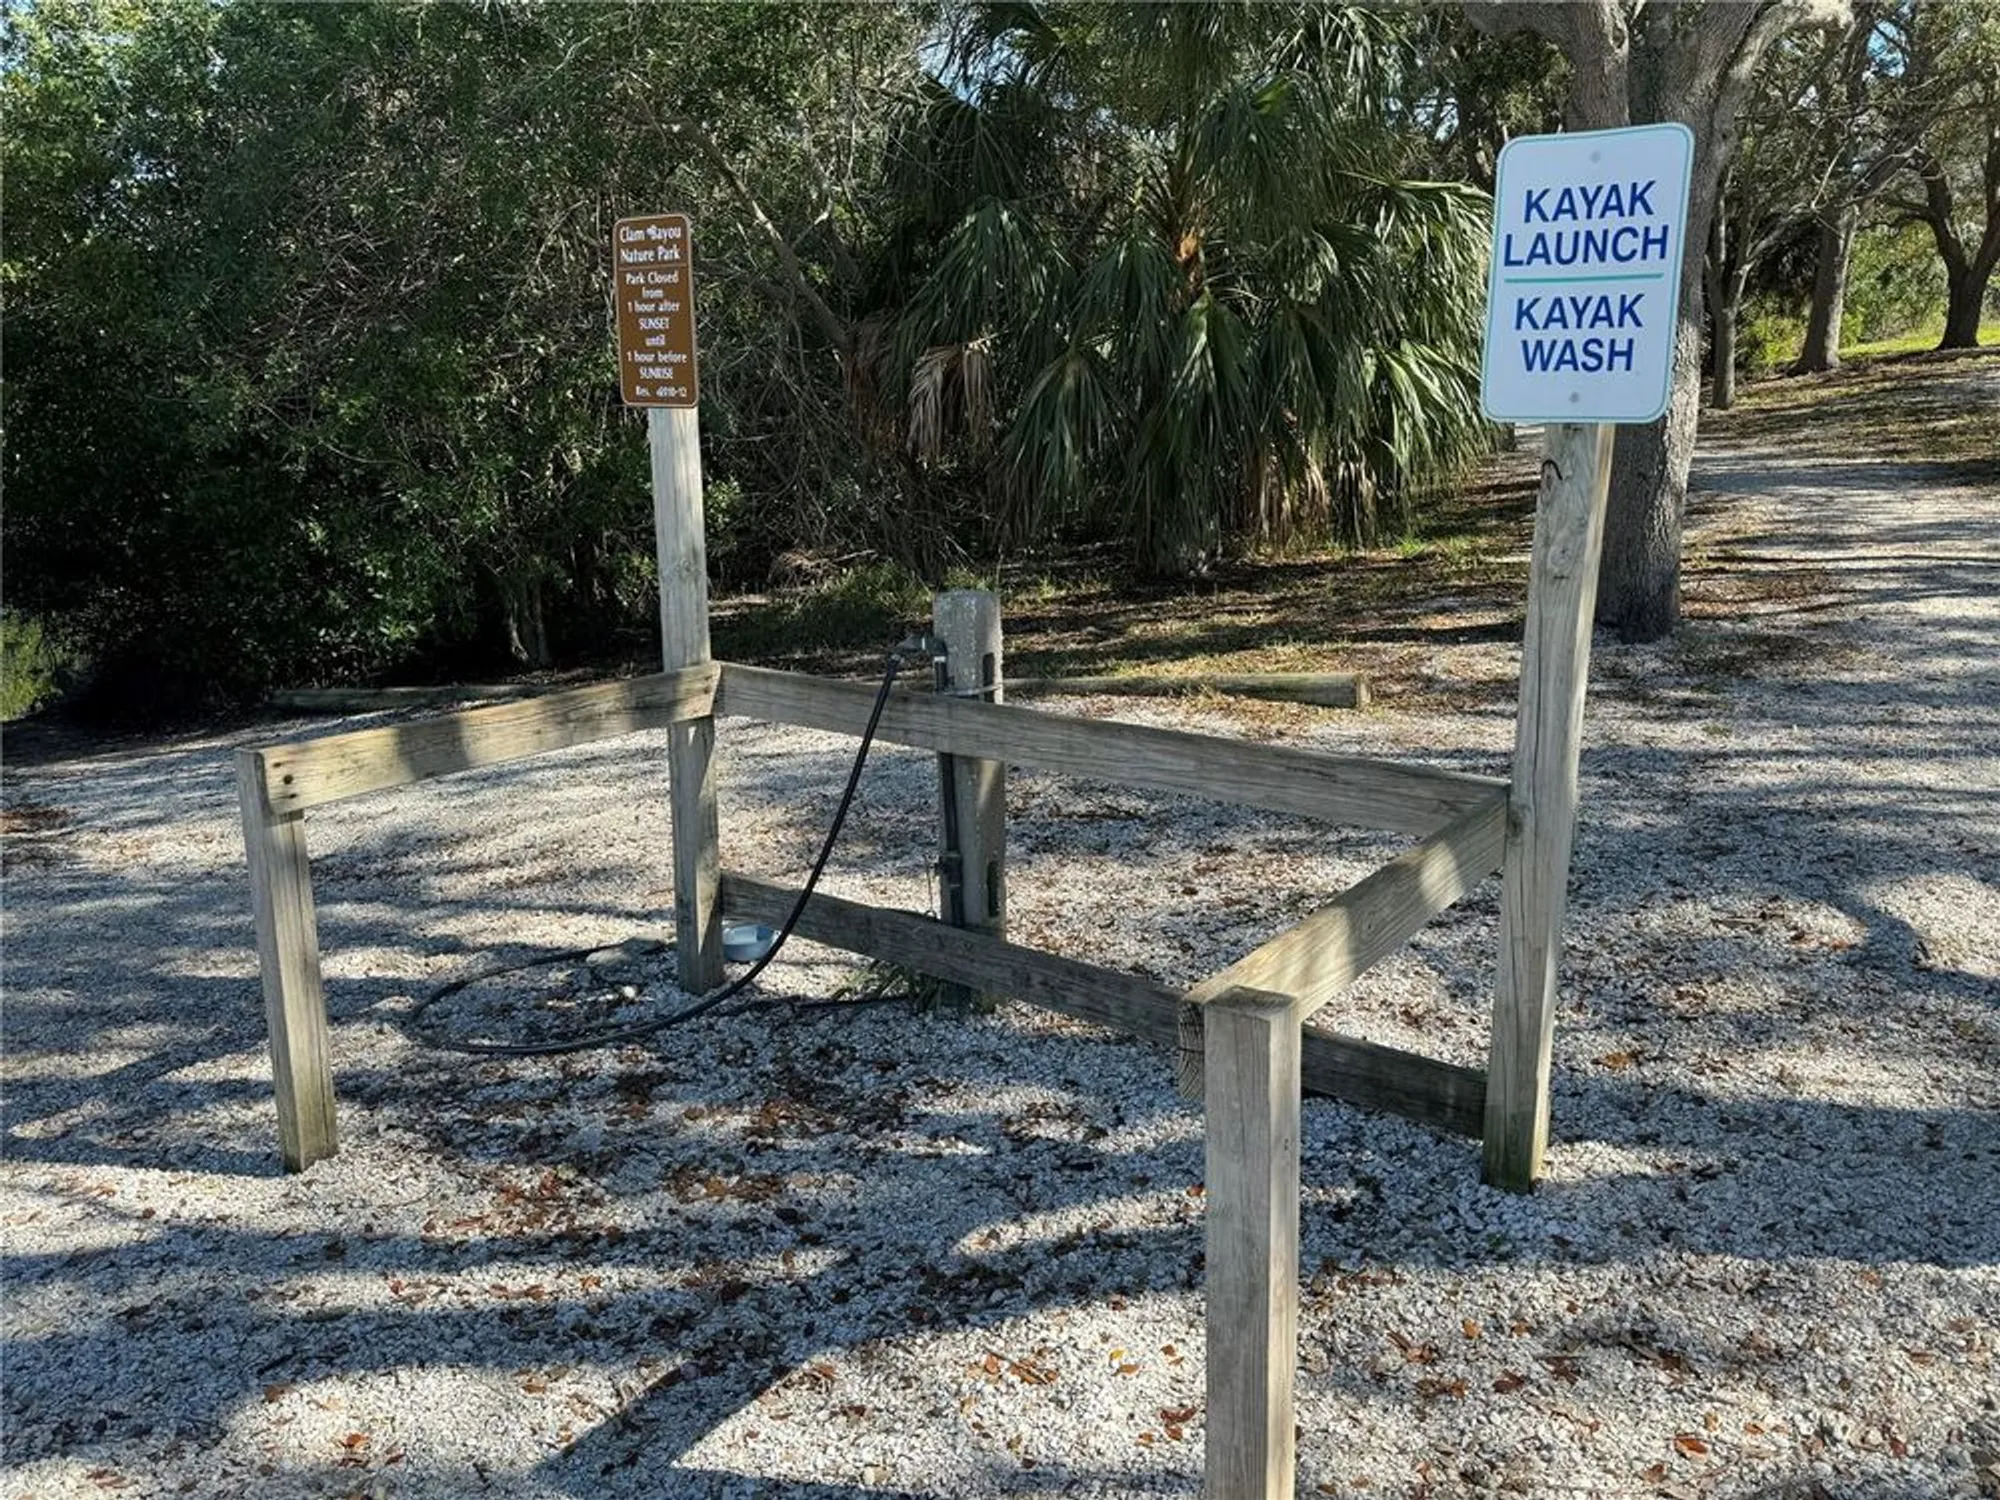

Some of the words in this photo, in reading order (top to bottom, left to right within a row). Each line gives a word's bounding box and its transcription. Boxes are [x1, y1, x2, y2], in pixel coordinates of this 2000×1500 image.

[1523, 180, 1656, 224] KAYAK
[619, 226, 645, 243] Clam
[648, 223, 681, 243] Bayou
[1504, 224, 1669, 267] LAUNCH
[620, 248, 655, 263] Nature
[657, 244, 680, 261] Park
[626, 272, 645, 285] Park
[648, 270, 679, 284] Closed
[642, 286, 664, 298] from
[627, 301, 633, 313] 1
[634, 300, 655, 312] hour
[658, 299, 680, 312] after
[1515, 293, 1646, 331] KAYAK
[638, 316, 670, 330] SUNSET
[645, 335, 666, 347] until
[627, 350, 632, 362] 1
[634, 350, 655, 362] hour
[657, 350, 687, 363] before
[1521, 338, 1635, 373] WASH
[639, 366, 673, 380] SUNRISE
